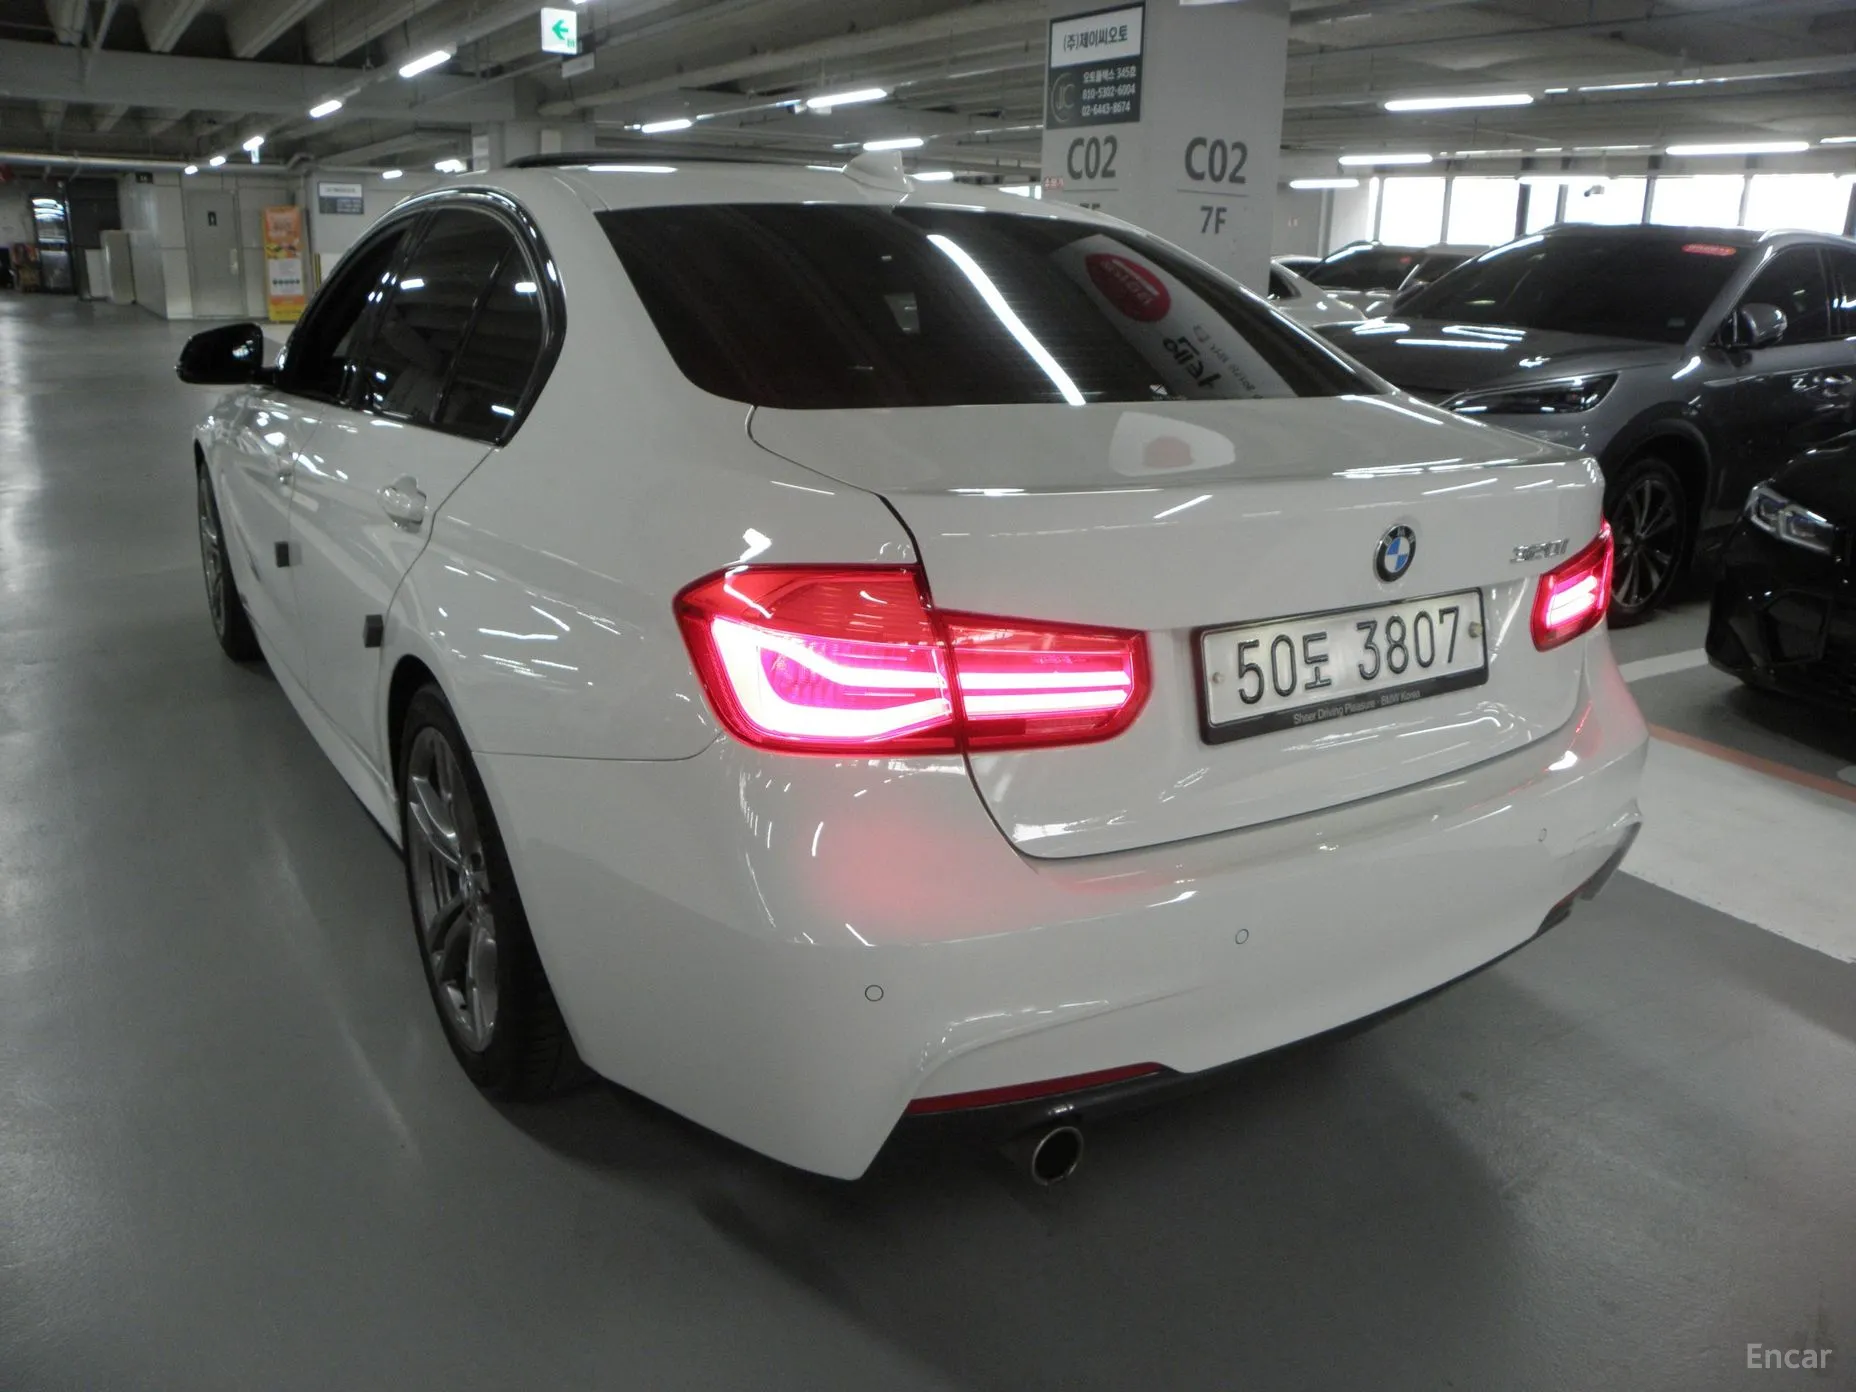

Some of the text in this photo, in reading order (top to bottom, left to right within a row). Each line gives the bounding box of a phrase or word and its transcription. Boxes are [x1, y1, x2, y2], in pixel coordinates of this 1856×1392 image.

[1067, 135, 1118, 180] C02
[1184, 137, 1249, 184] C02
[1200, 206, 1227, 234] 7F
[1237, 606, 1460, 705] 50도 3807
